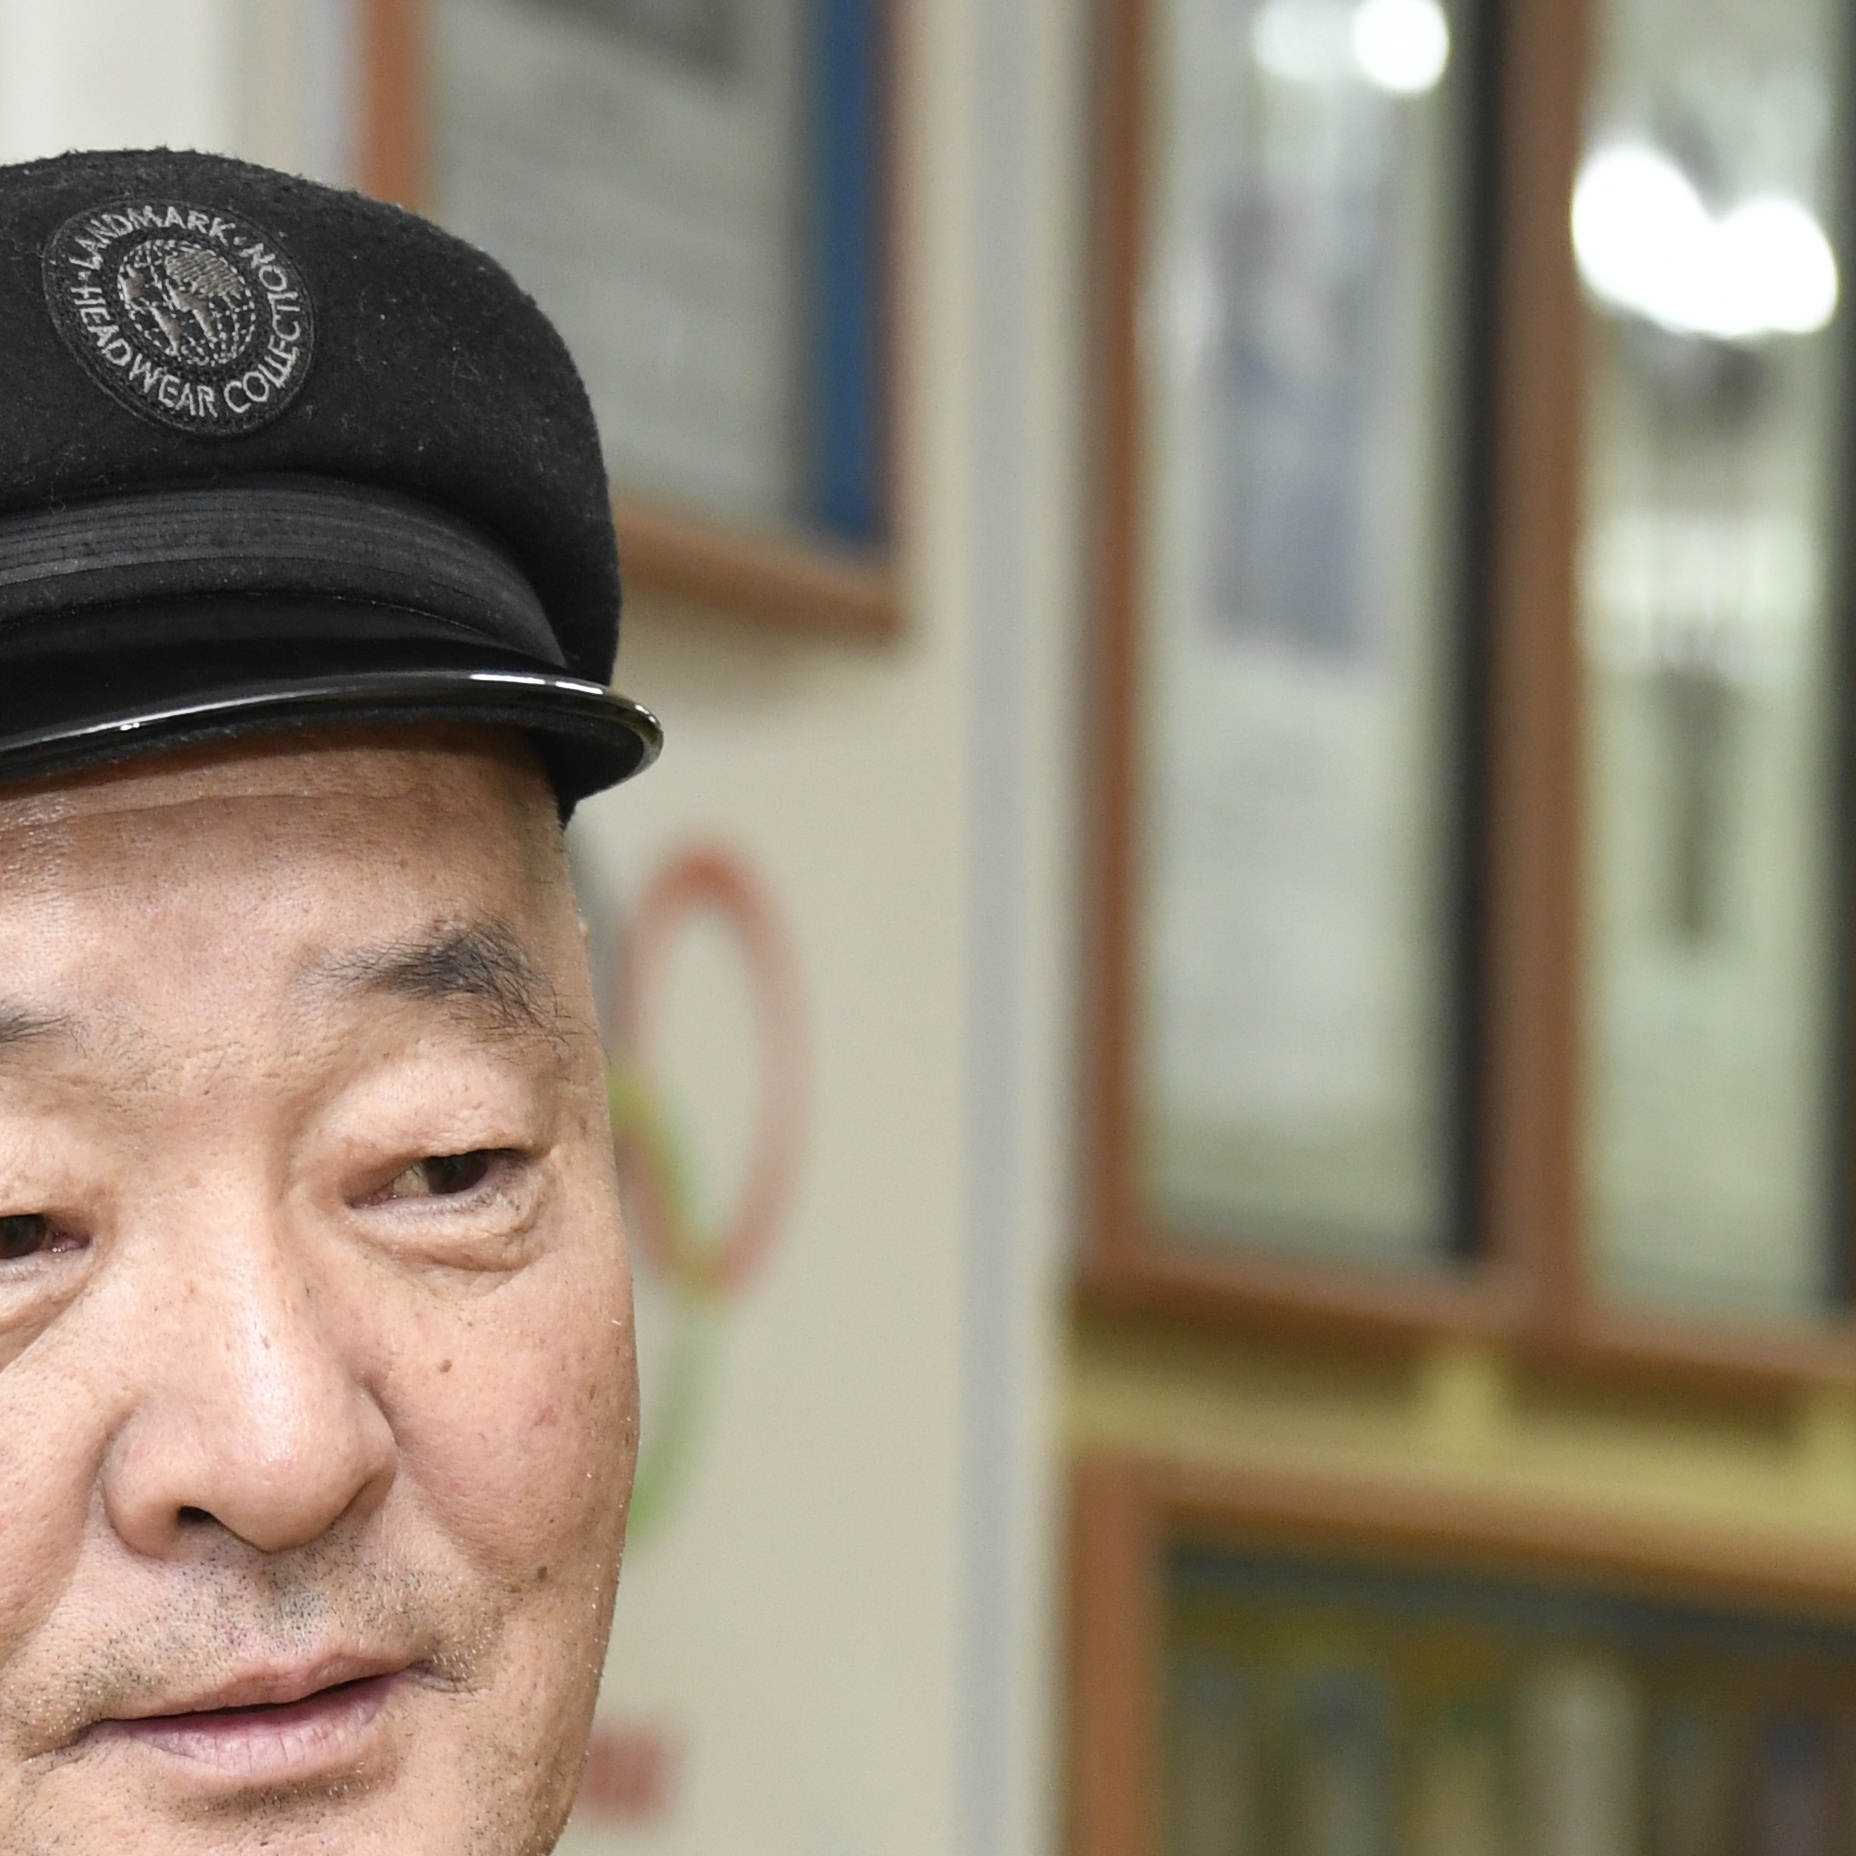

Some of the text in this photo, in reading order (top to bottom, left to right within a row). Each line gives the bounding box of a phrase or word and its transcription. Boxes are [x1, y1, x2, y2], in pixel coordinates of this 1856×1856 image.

[69, 205, 236, 271] LANDMARK
[70, 242, 301, 418] HEADWEAR COLLECTION
